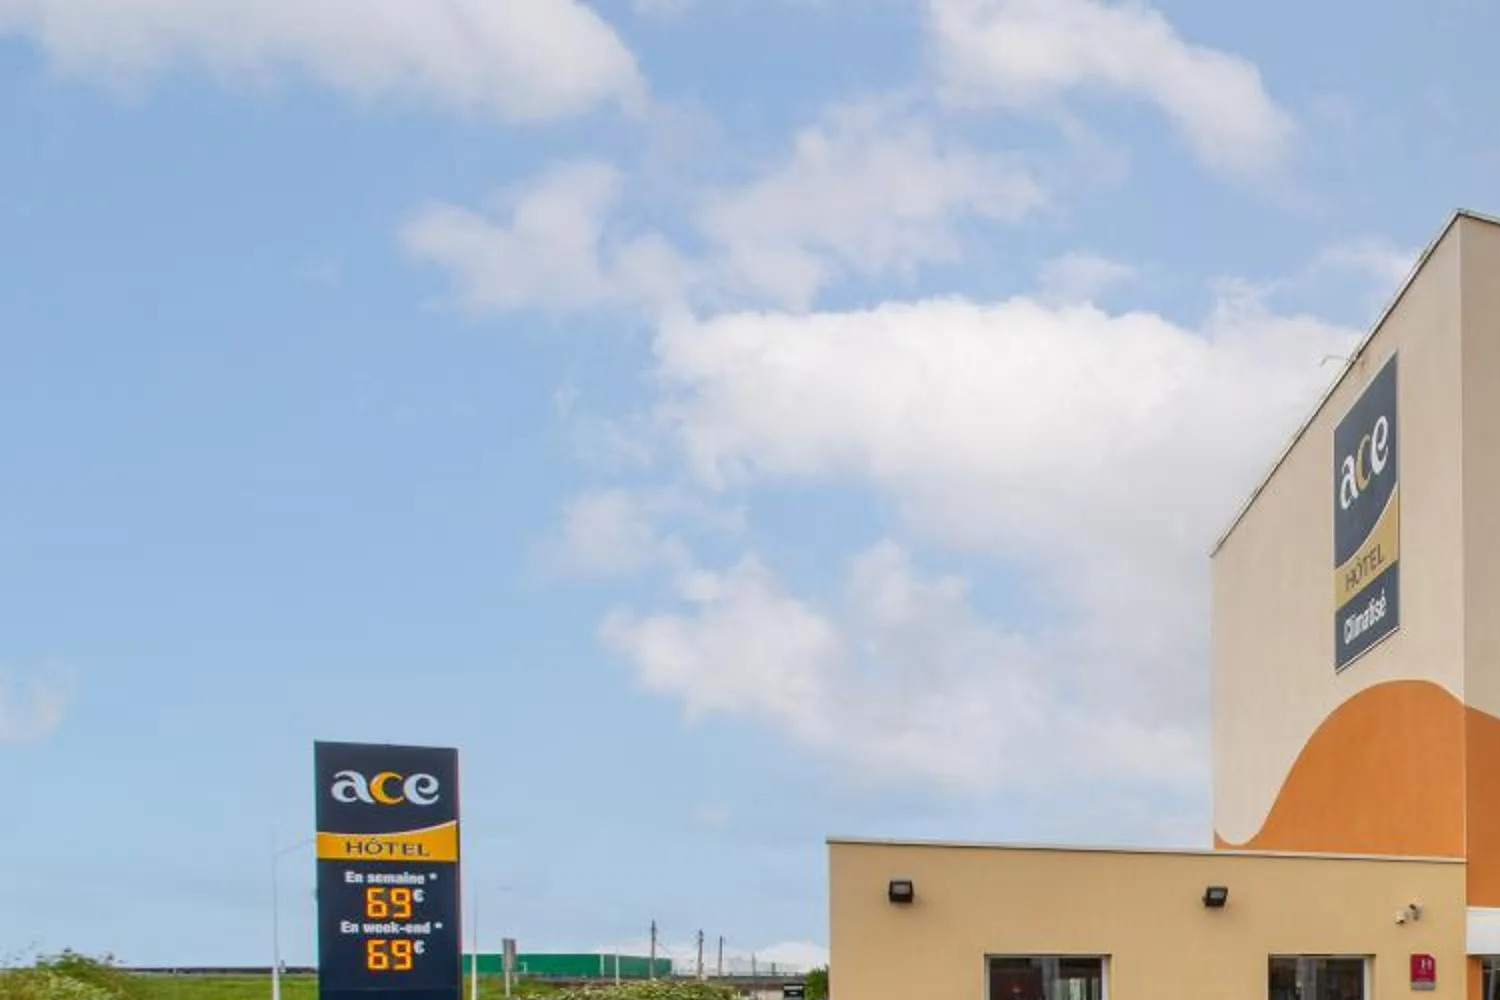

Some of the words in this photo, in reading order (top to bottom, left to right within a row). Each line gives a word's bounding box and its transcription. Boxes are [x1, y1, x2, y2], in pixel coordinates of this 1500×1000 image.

[1340, 414, 1389, 511] ace
[1345, 543, 1384, 593] HÔTEL
[1343, 587, 1387, 645] Climatisé
[331, 769, 440, 806] ace
[345, 837, 431, 857] HÔTEL
[344, 870, 364, 884] En
[367, 872, 425, 886] semaine
[340, 920, 360, 934] En
[363, 920, 431, 935] week-end
